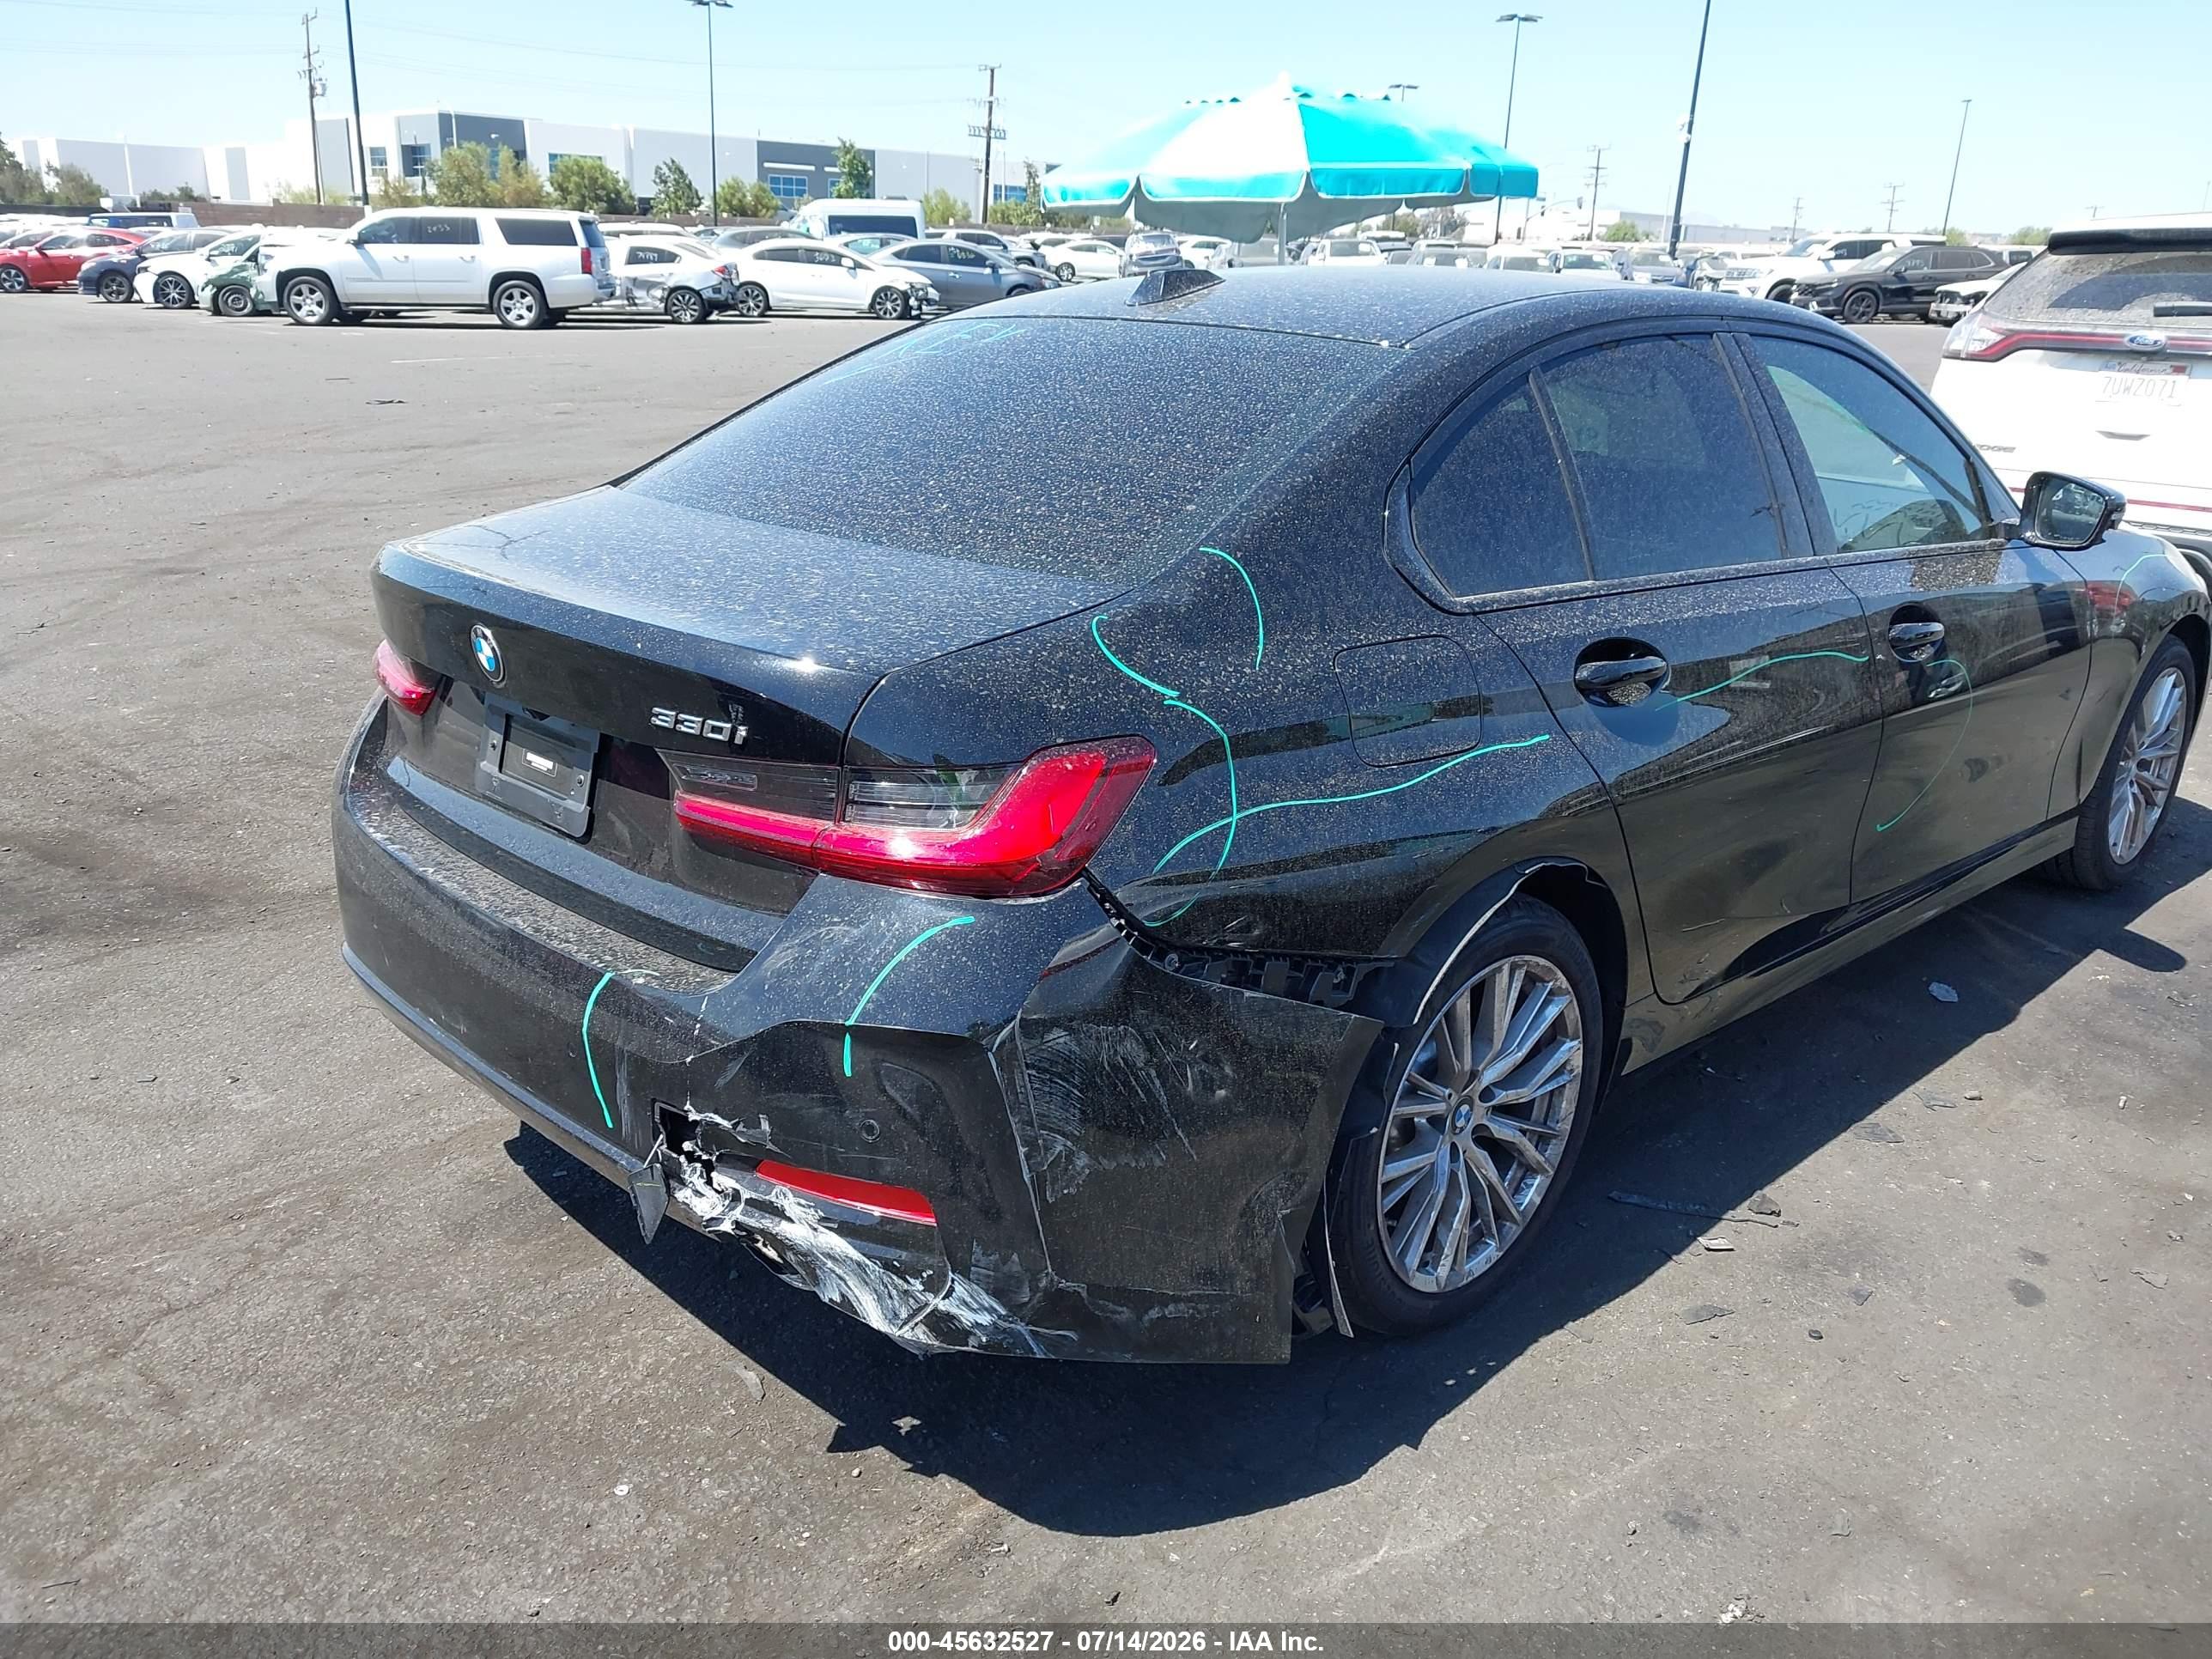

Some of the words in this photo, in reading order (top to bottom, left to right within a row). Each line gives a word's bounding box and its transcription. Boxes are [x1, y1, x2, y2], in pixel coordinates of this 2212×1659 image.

[2102, 376, 2177, 398] 7UWZ071
[1975, 443, 2016, 453] DGE
[650, 707, 749, 745] 330i
